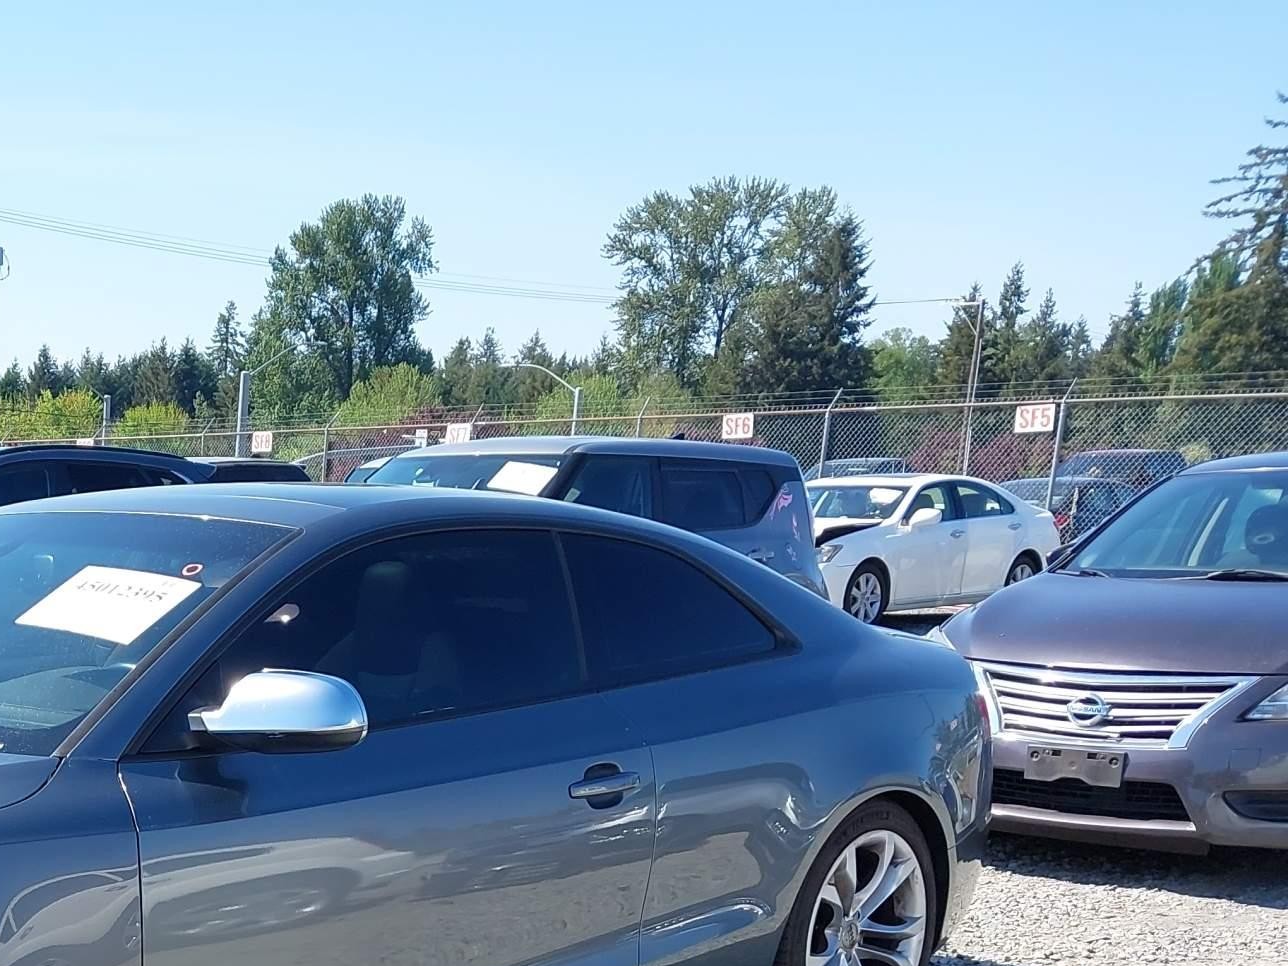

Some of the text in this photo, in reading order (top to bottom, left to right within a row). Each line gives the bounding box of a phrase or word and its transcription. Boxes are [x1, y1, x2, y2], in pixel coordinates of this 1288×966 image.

[725, 416, 751, 436] SF6
[1018, 407, 1052, 429] SF5
[254, 434, 271, 450] SF8
[1071, 705, 1102, 713] SAN
